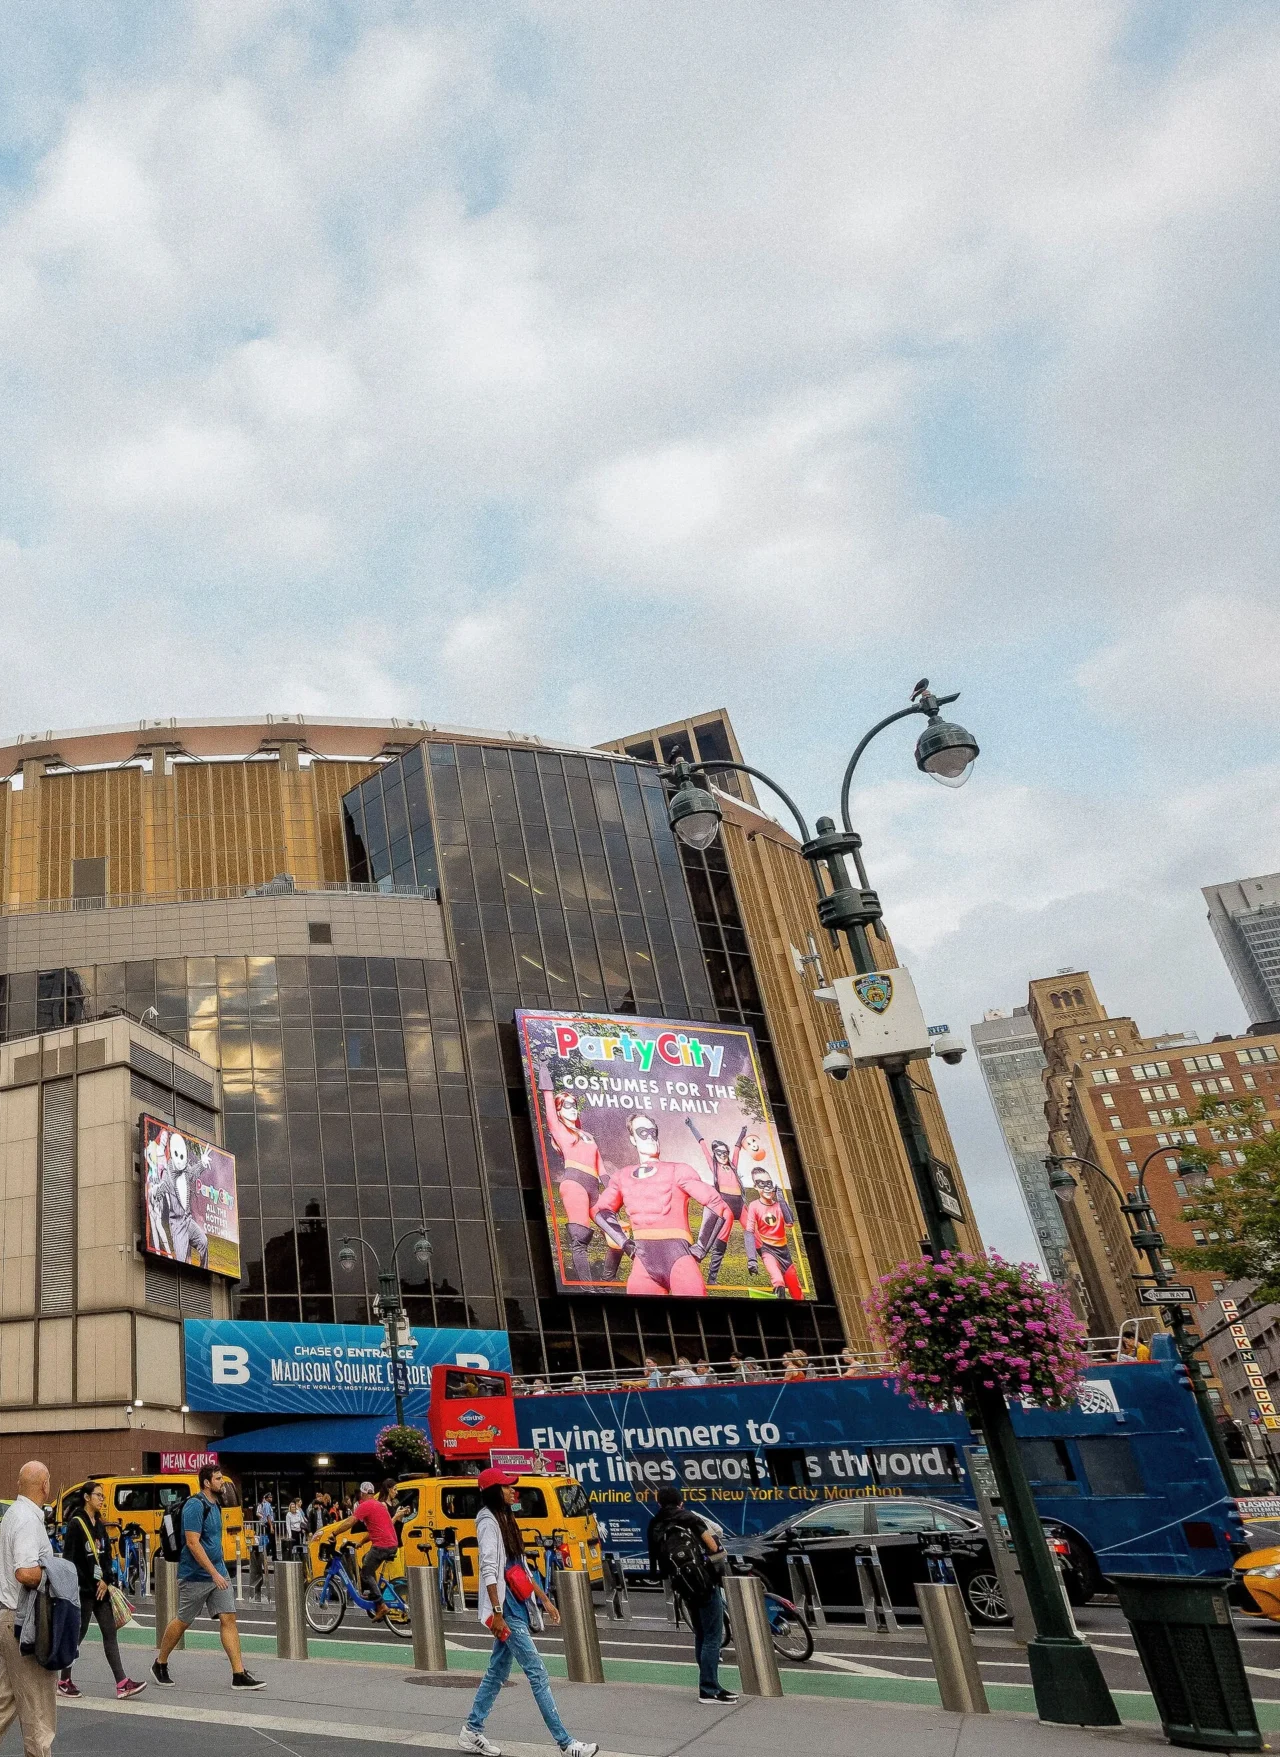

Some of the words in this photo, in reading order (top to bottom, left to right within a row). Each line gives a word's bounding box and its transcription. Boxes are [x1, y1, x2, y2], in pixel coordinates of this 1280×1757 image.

[927, 1025, 949, 1035] NYPD
[554, 1025, 656, 1072] Party
[656, 1032, 726, 1078] City
[828, 1041, 849, 1050] NYPD
[562, 1075, 659, 1094] COSTUMES
[666, 1082, 701, 1097] FOR
[706, 1084, 737, 1100] THE
[585, 1092, 653, 1111] WHOLE
[660, 1098, 720, 1115] FAMILY
[195, 1179, 220, 1205] Party
[219, 1188, 234, 1210] City
[206, 1203, 216, 1214] ALL
[217, 1206, 227, 1218] THE
[294, 1346, 331, 1357] CHASE
[211, 1345, 250, 1385] B
[271, 1358, 331, 1383] MADISON
[335, 1360, 383, 1384] SQUARE
[386, 1361, 432, 1385] GRDEN
[531, 1425, 618, 1453] Flying
[624, 1424, 741, 1449] runners
[746, 1419, 781, 1445] to
[162, 1454, 186, 1469] MEAN
[609, 1455, 677, 1482] lines
[589, 1489, 631, 1502] Airline
[636, 1488, 649, 1502] of
[681, 1487, 707, 1501] TCS
[711, 1486, 744, 1500] New
[748, 1485, 783, 1500] York
[788, 1486, 818, 1503] City
[824, 1484, 903, 1499] Marathon
